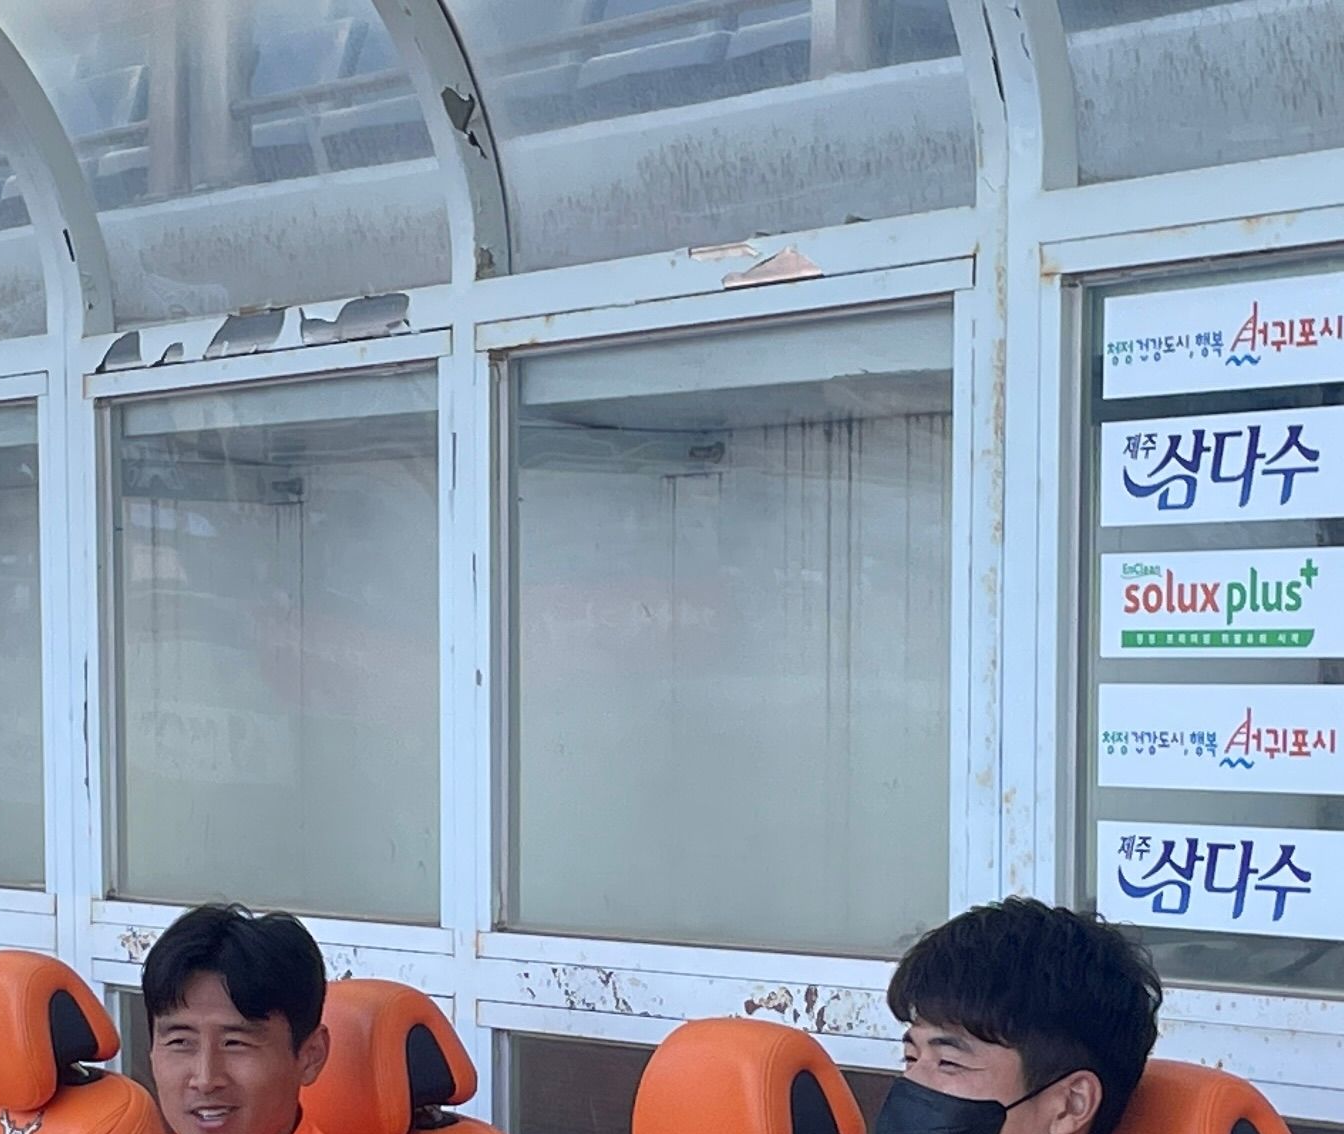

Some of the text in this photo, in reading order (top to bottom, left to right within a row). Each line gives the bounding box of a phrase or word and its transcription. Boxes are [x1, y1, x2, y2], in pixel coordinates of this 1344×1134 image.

[1230, 301, 1343, 352] 서귀포시
[1123, 424, 1320, 512] 제주 삼다수
[1123, 568, 1221, 614] solux
[1224, 707, 1337, 760] 서귀포시
[1118, 834, 1312, 922] 제주 삼다수
